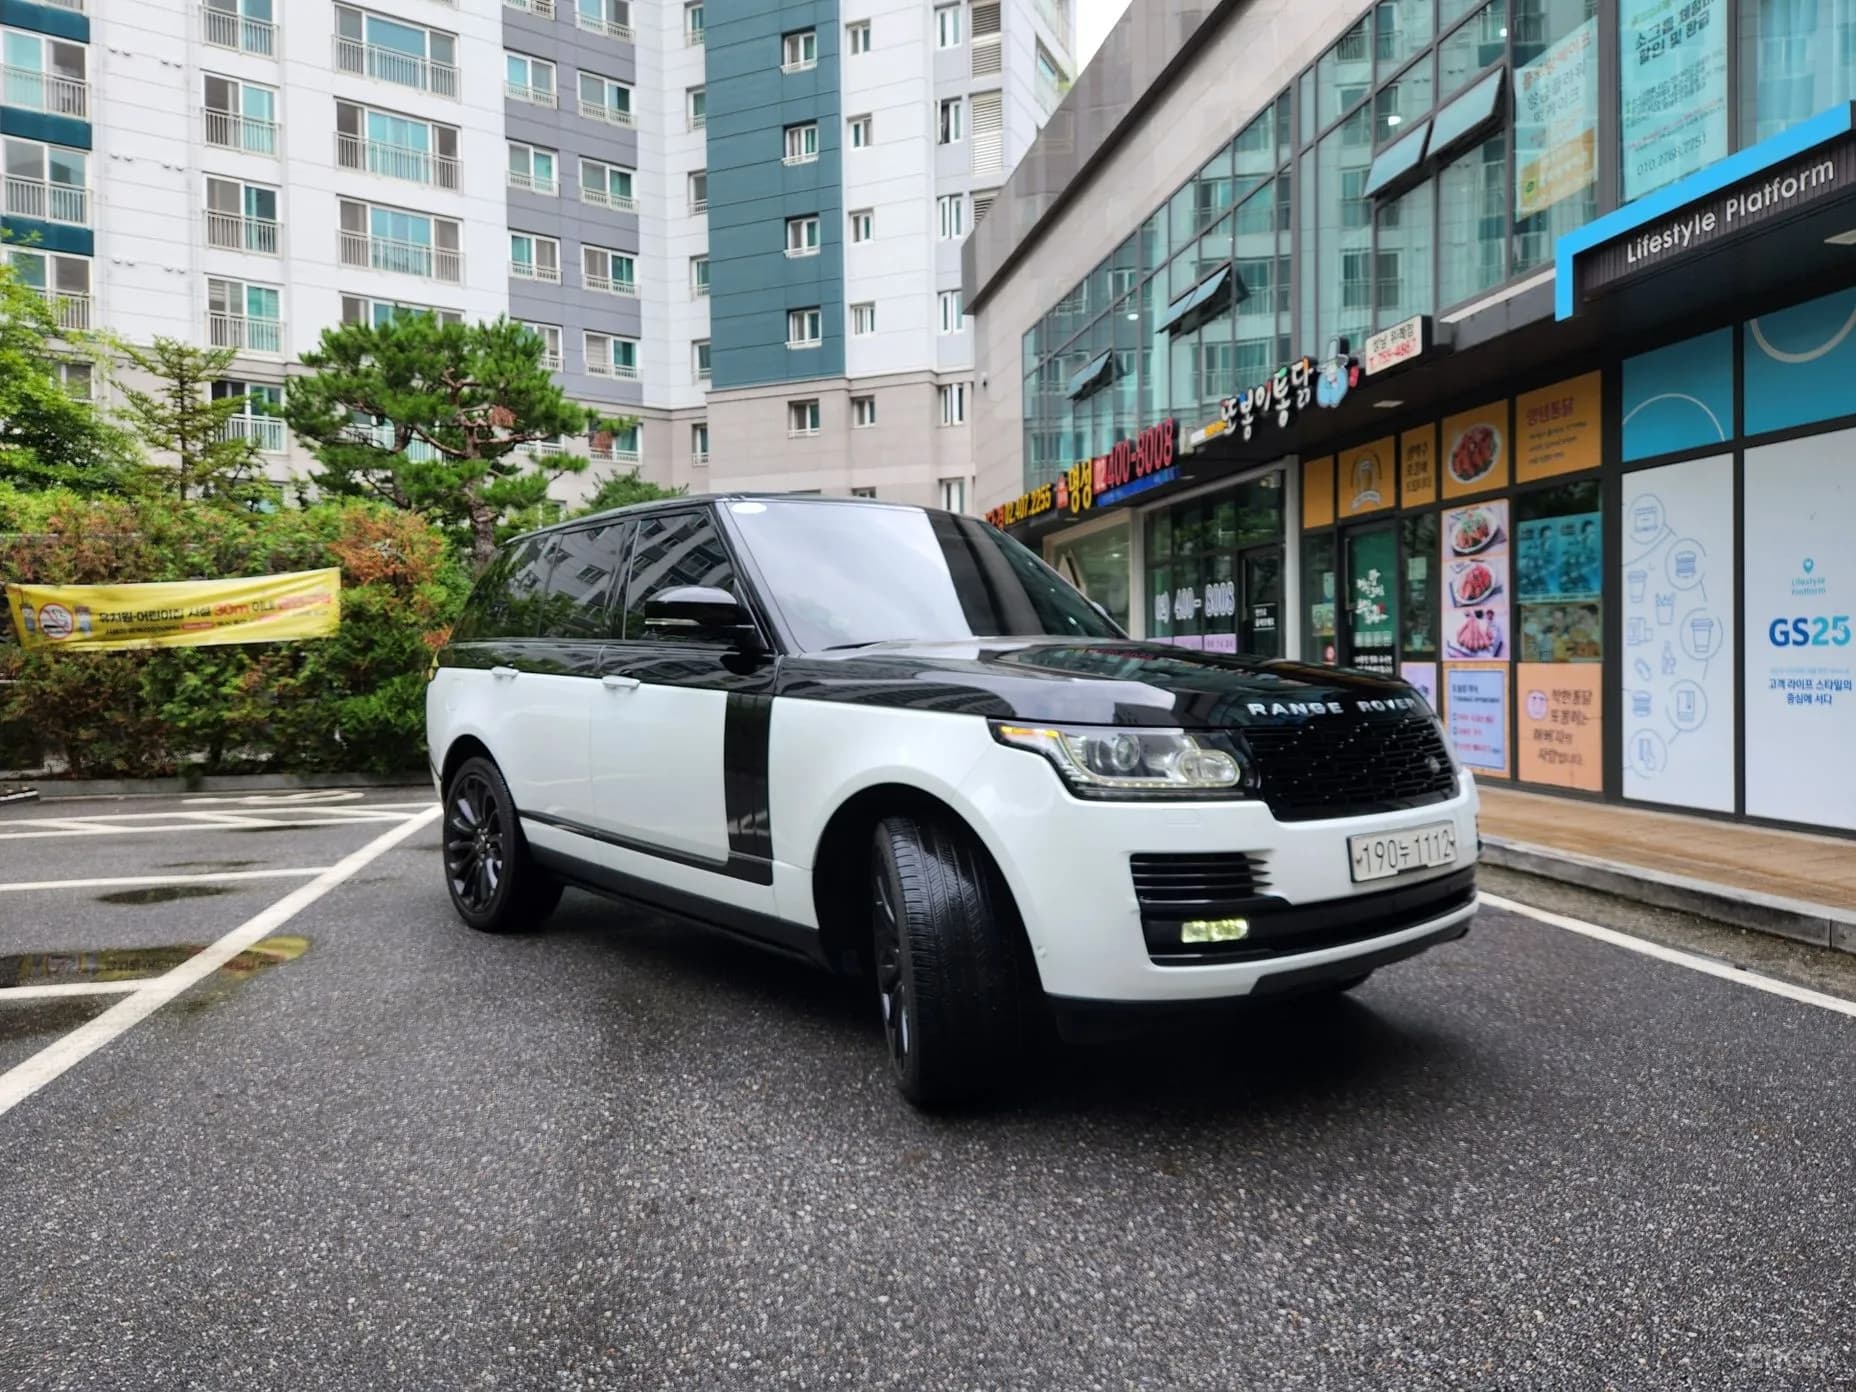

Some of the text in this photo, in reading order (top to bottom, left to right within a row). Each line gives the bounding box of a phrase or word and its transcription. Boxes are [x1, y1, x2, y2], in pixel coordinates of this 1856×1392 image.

[1627, 160, 1834, 263] Lifestyle Platform
[1221, 357, 1313, 440] 또봉이통닭
[1107, 417, 1174, 488] 400-8008
[1768, 616, 1851, 647] GS25
[1769, 679, 1852, 692] 고객 라이프 스타일의
[1815, 693, 1833, 705] 서다
[1247, 697, 1417, 716] RANGE ROVER
